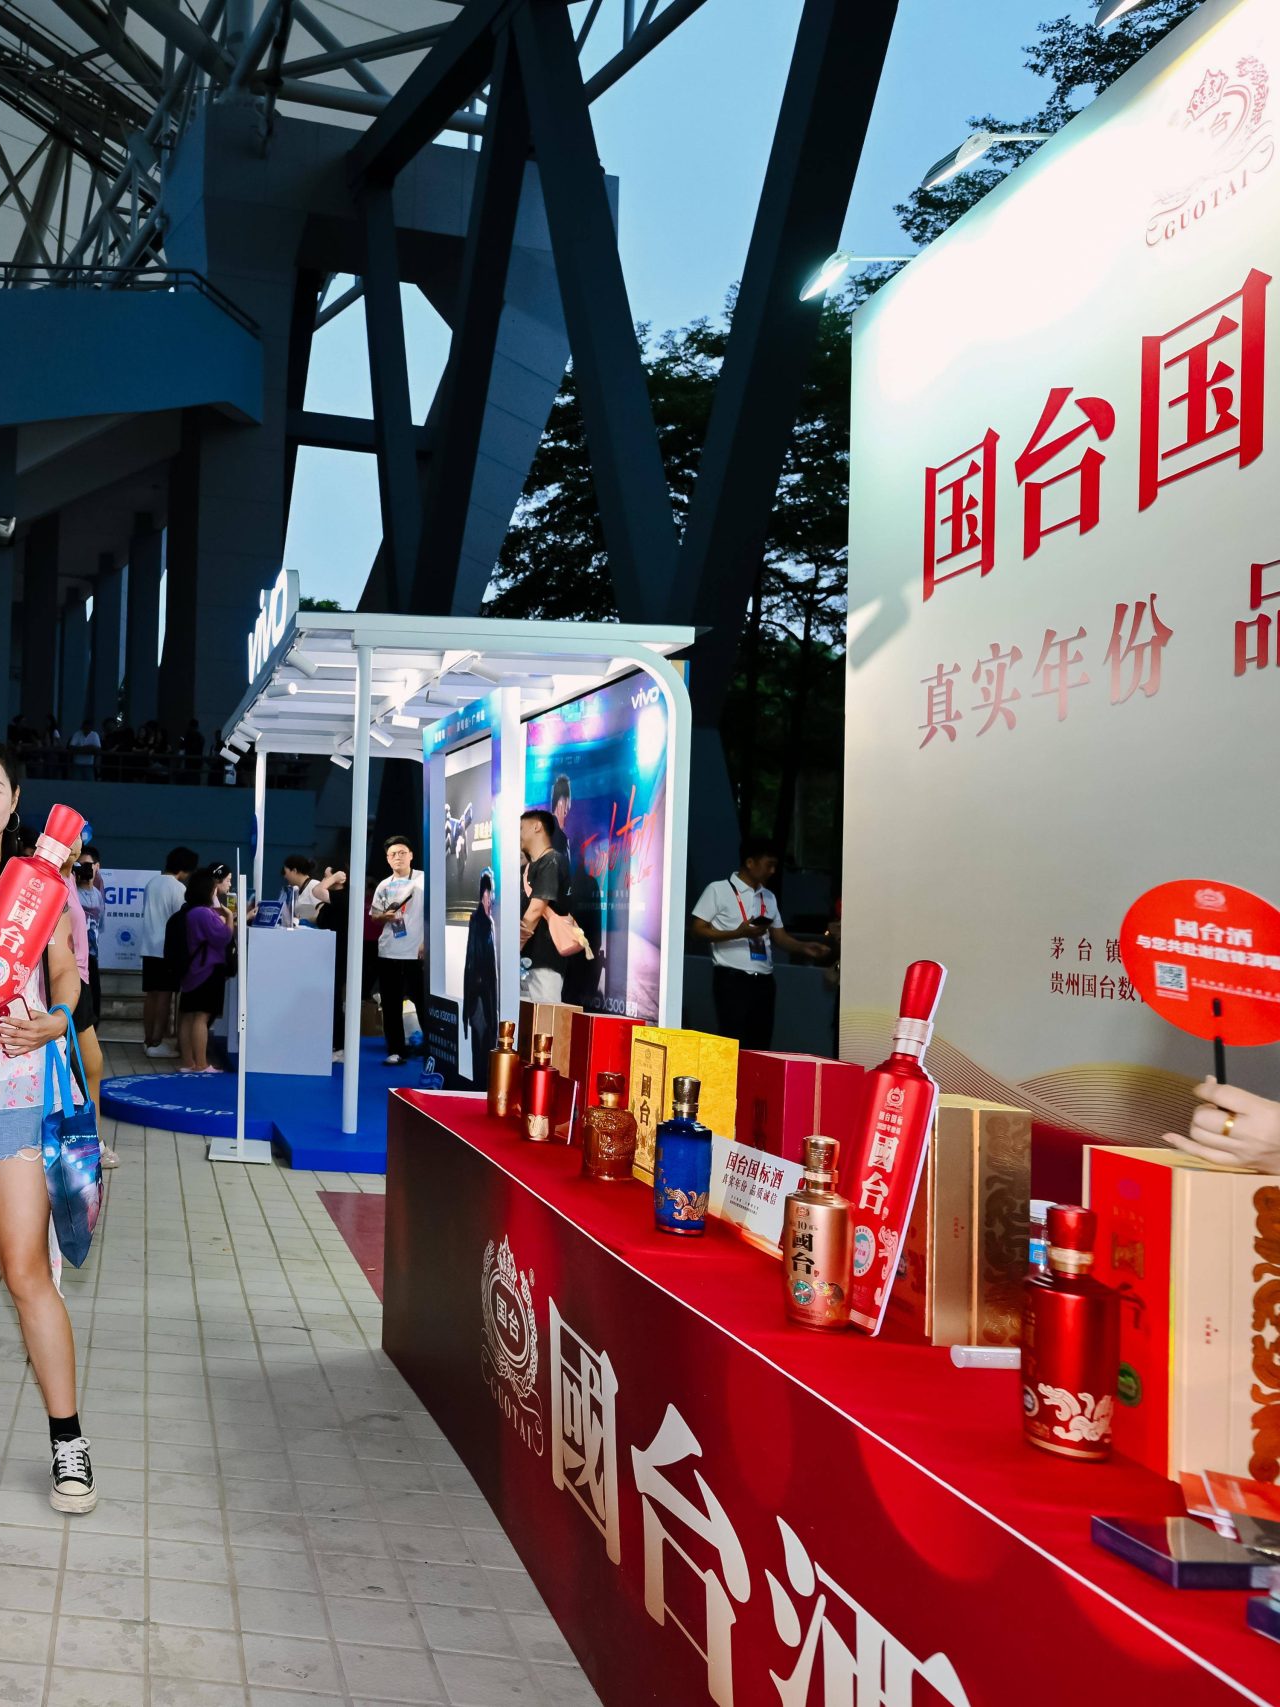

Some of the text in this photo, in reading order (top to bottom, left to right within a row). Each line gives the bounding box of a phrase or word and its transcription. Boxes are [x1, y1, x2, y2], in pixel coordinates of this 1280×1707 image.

[1164, 170, 1248, 240] GUOTAI
[923, 268, 1272, 603] 国台国
[248, 567, 287, 685] vivo
[631, 686, 660, 709] vivo
[918, 593, 1174, 750] 真实年份
[1050, 970, 1144, 1004] 贵州国台数
[722, 1173, 748, 1193] 真实年份
[749, 1184, 778, 1206] 品质诚信
[726, 1151, 785, 1190] 国台国标酒
[859, 1130, 900, 1215] 國台
[792, 1230, 815, 1275] 國台
[496, 1292, 520, 1343] 国台
[489, 1381, 532, 1450] GUOTAI
